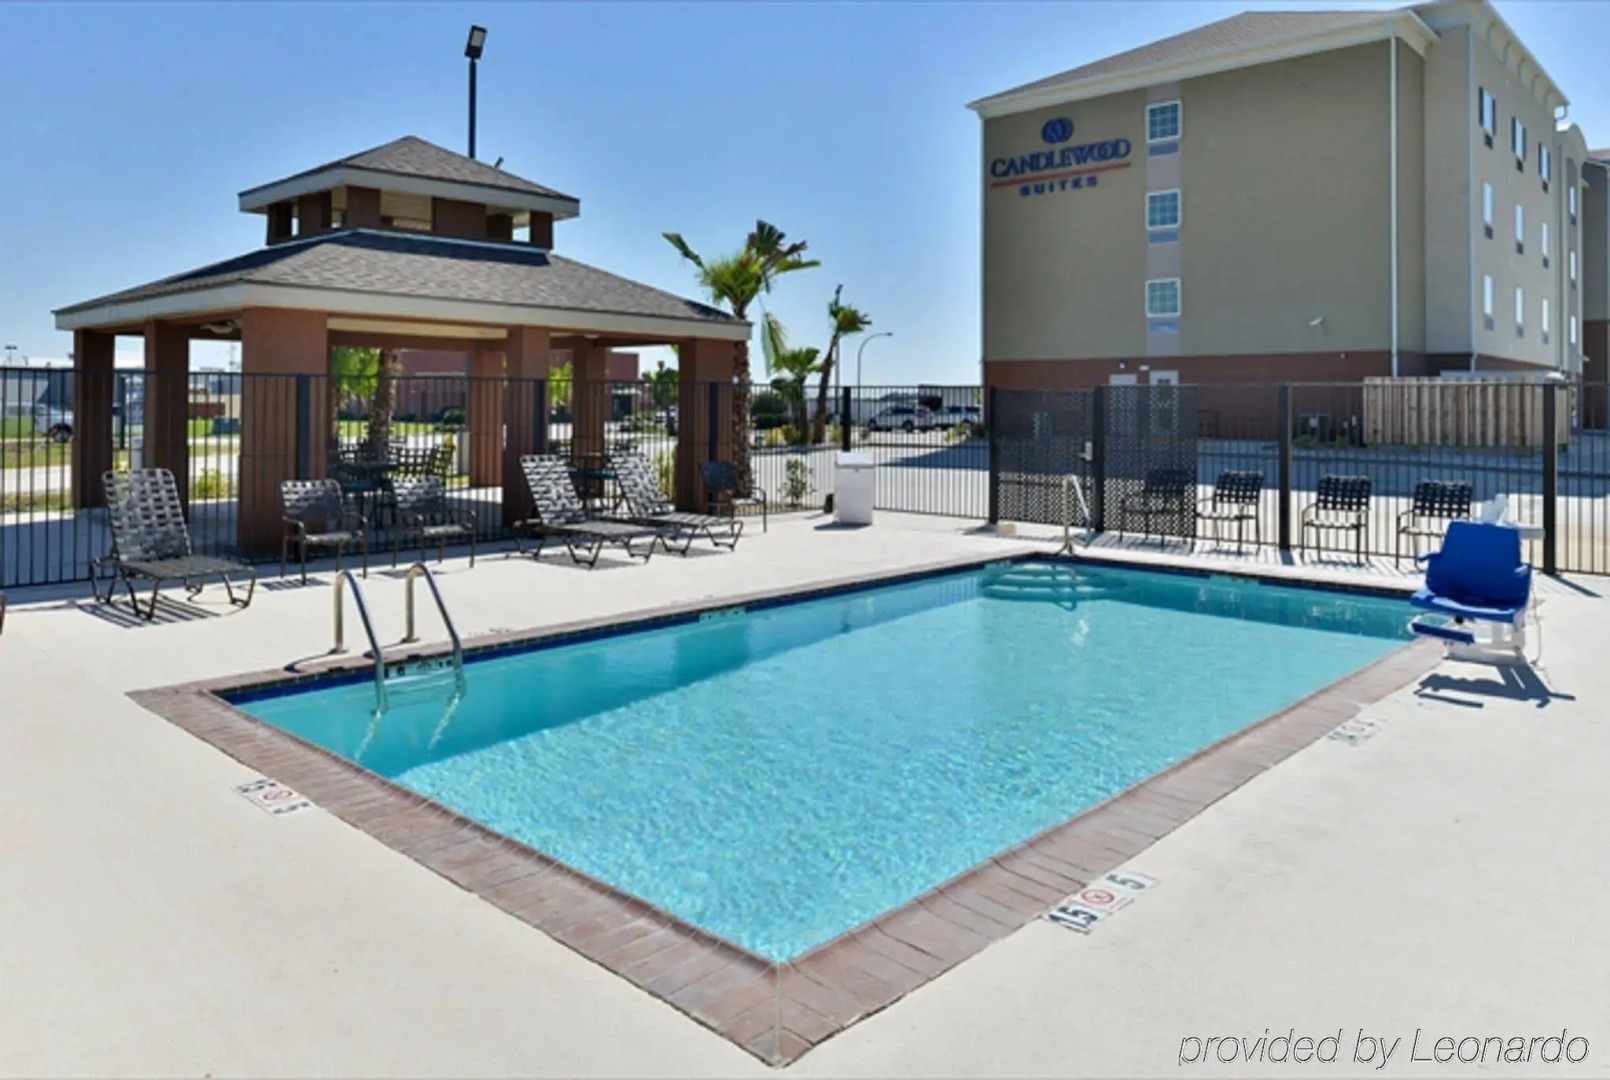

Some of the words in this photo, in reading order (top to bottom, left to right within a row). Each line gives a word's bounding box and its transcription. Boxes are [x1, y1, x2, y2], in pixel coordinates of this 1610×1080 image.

[990, 138, 1131, 177] CANDLEWOOD
[1020, 176, 1098, 196] SUITES
[1106, 874, 1146, 890] 5
